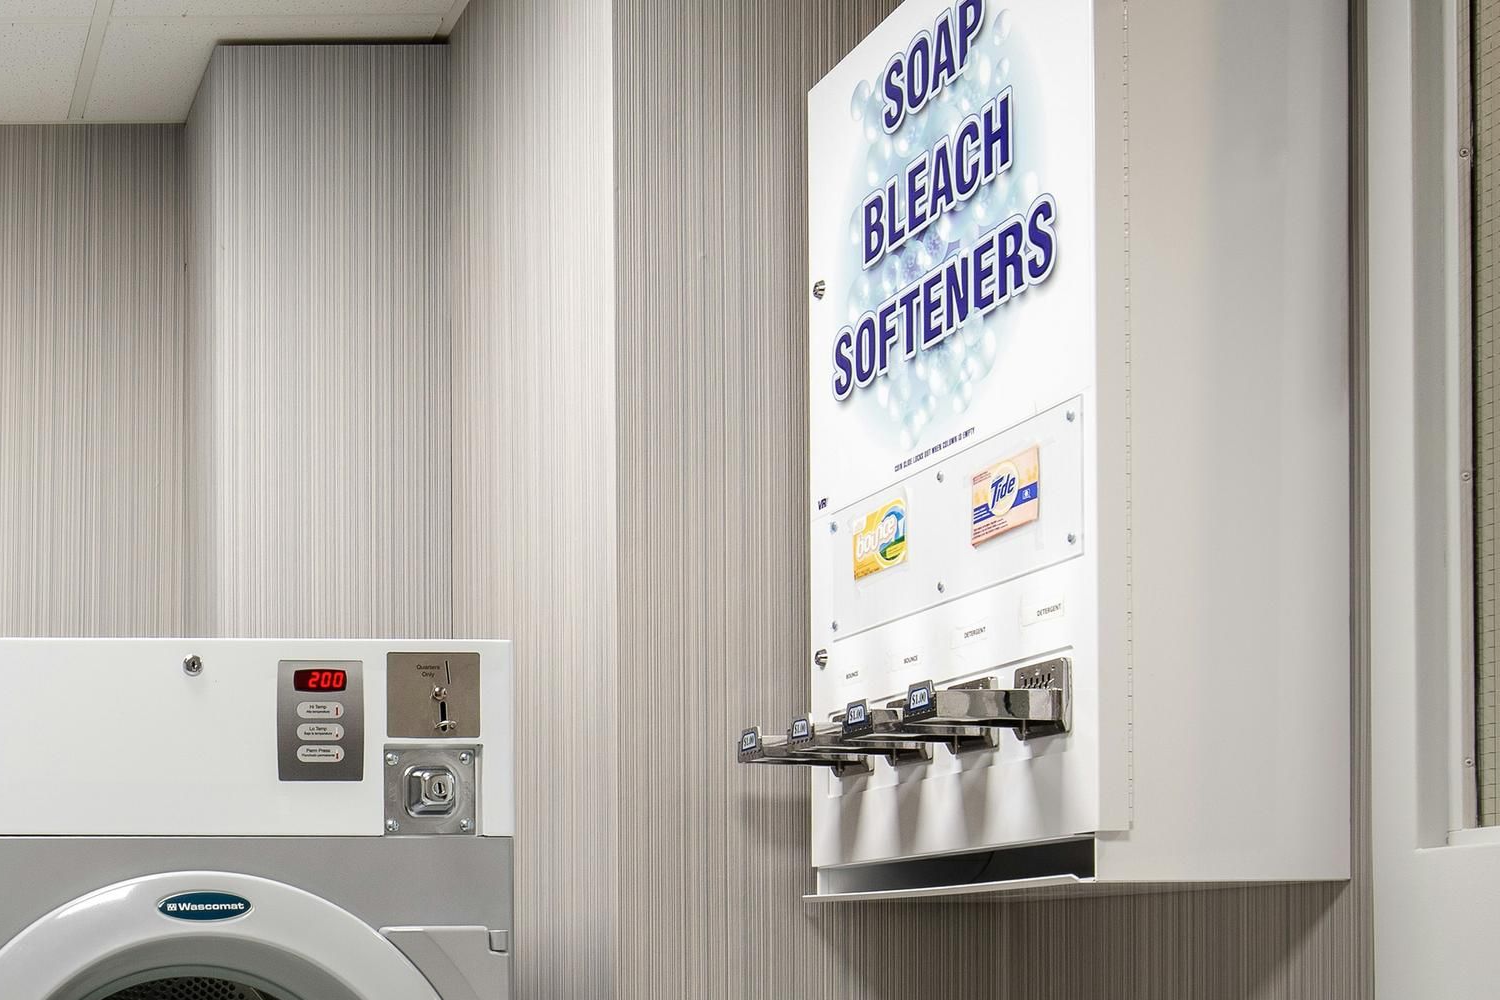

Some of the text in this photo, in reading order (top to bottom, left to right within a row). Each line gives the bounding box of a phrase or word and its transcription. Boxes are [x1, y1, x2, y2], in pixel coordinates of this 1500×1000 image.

[882, 0, 985, 131] SOAP
[862, 92, 1012, 267] BLEACH
[833, 198, 1056, 398] SOFTENERS
[990, 473, 1016, 510] Tide
[856, 518, 898, 560] bounce
[1036, 603, 1062, 616] DETERGENT
[964, 626, 986, 639] DETERGENT
[308, 671, 344, 688] 200
[911, 691, 927, 706] $1.00
[849, 708, 863, 722] $1.00
[794, 722, 805, 735] $1.00
[743, 734, 755, 748] $1.00
[178, 903, 245, 912] Wascomat
